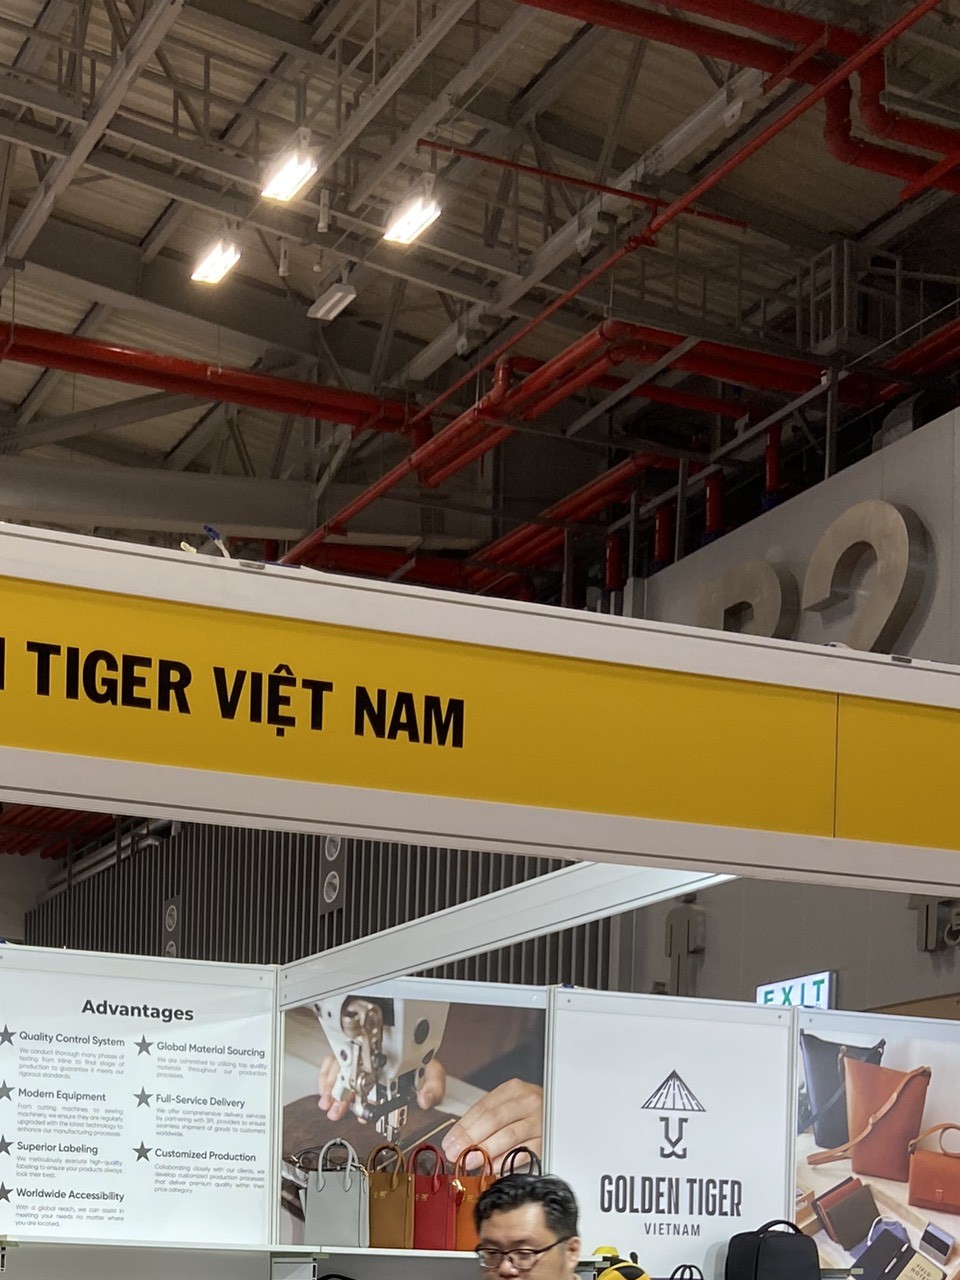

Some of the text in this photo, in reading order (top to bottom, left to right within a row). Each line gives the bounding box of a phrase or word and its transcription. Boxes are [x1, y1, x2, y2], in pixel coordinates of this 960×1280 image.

[26, 641, 192, 714] TIGER
[213, 664, 333, 736] VIỆT
[354, 685, 465, 748] NAM
[82, 1000, 194, 1023] Advantages
[20, 1031, 125, 1047] Quality Control System
[157, 1042, 265, 1059] Global Material Sourcing
[18, 1088, 106, 1102] Modern Equipment
[156, 1094, 245, 1109] Full-Service Delivery
[17, 1141, 98, 1155] Superior Labeling
[155, 1148, 256, 1161] Customized Production
[16, 1188, 124, 1202] Worldwide Accessibility
[600, 1174, 742, 1217] GOLDEN TIGER
[644, 1222, 700, 1236] VIETNAM
